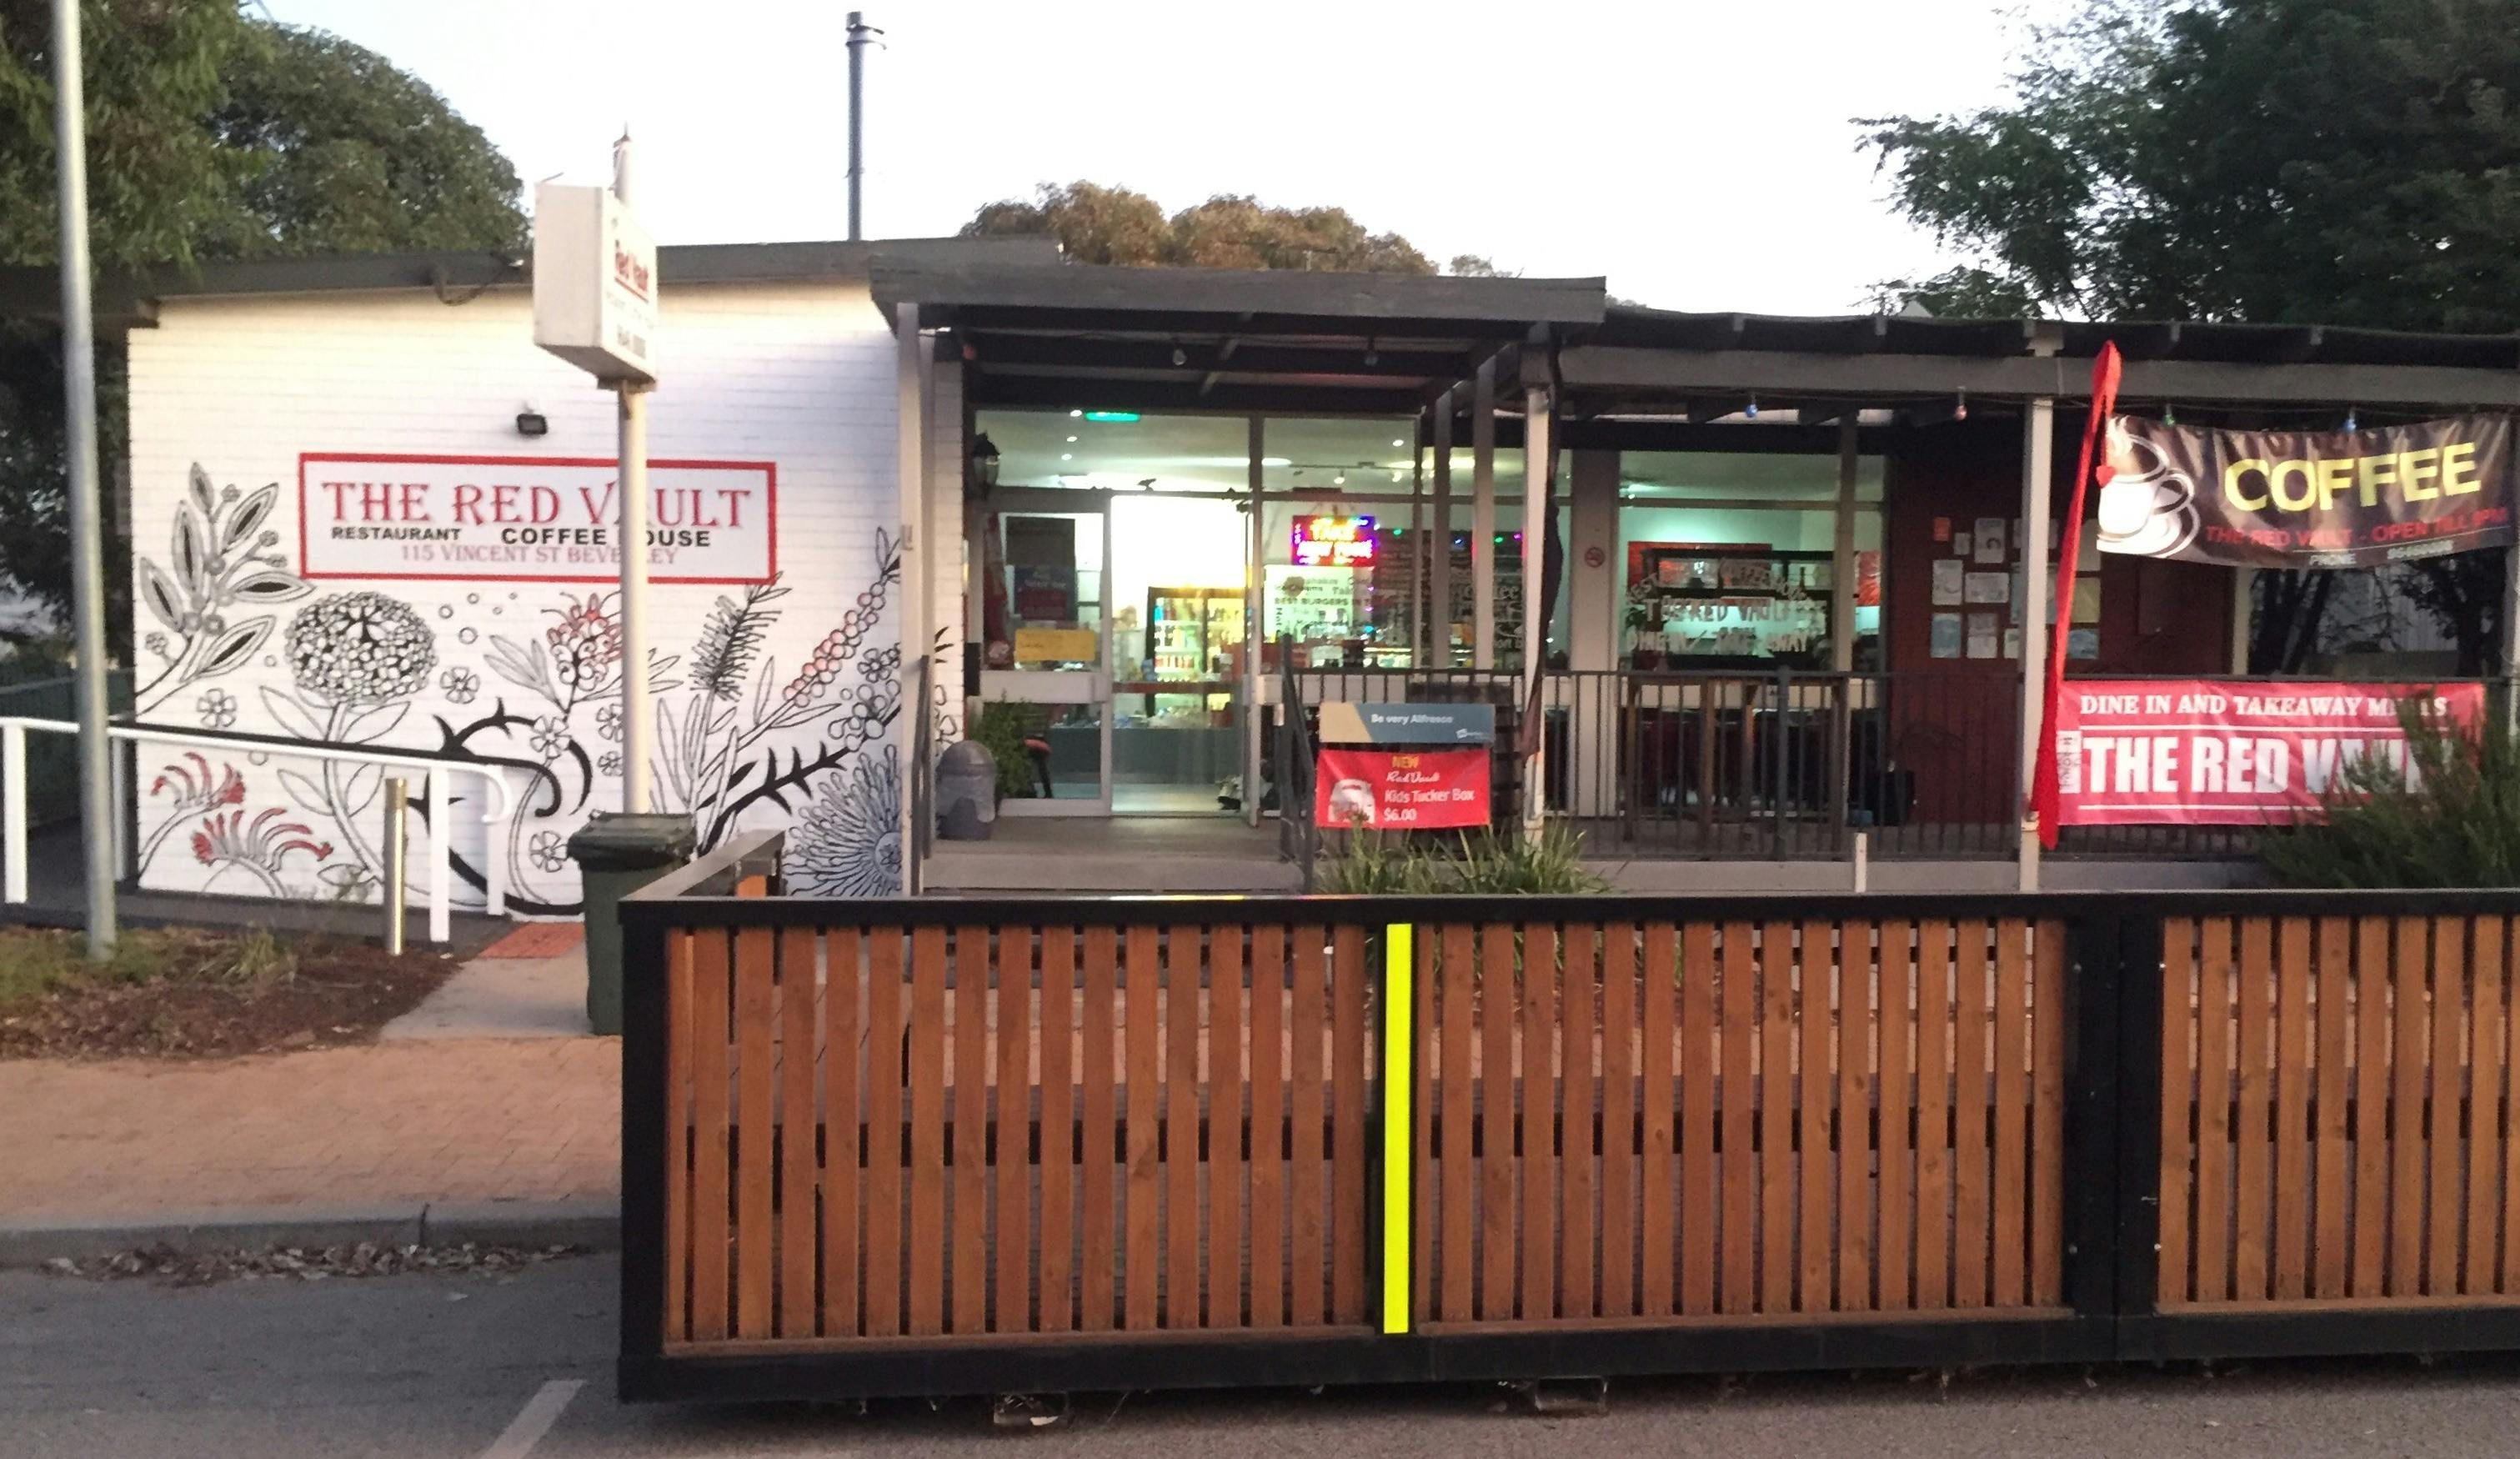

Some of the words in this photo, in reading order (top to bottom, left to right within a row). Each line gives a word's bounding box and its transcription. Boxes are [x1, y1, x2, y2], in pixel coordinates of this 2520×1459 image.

[2225, 443, 2481, 511] COFFEE
[322, 482, 430, 522] THE
[452, 484, 561, 525] RED
[579, 481, 752, 528] VULT
[331, 526, 462, 540] RESTAURANT
[501, 528, 607, 545] COFFEE
[2371, 521, 2427, 542] OPEN
[402, 544, 434, 561] 115
[441, 545, 528, 562] VINCENT
[535, 546, 562, 563] ST
[568, 547, 679, 564] BEVEEY
[2080, 694, 2139, 714] DINE
[2145, 694, 2171, 714] IN
[2177, 694, 2227, 714] AND
[2232, 696, 2363, 716] TAKEAWAY
[1371, 714, 1384, 724] Be
[1385, 716, 1410, 725] very
[1392, 755, 1419, 768] NEW
[2083, 737, 2178, 793] THE
[2191, 737, 2289, 794] RED
[1385, 790, 1410, 803] Kids
[1411, 789, 1450, 802] Tucker
[1451, 788, 1475, 801] Box
[1384, 807, 1417, 821] $6.00
